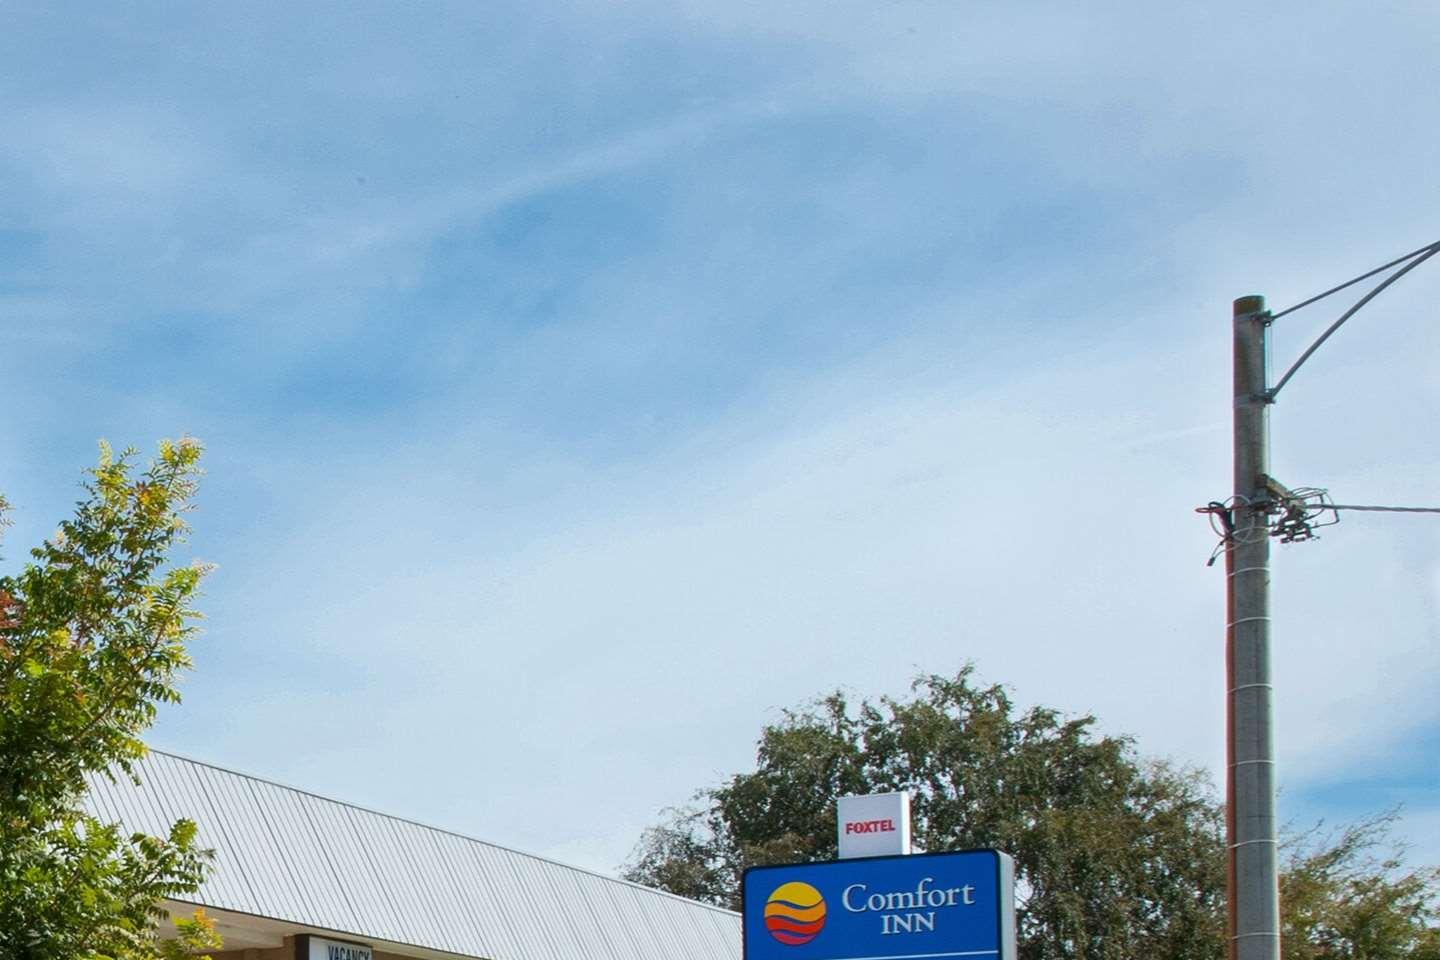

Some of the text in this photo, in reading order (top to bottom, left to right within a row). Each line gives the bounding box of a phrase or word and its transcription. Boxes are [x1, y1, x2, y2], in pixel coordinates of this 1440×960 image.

[845, 818, 896, 835] FOXTEL
[841, 877, 976, 913] Comfort
[880, 911, 936, 935] INN
